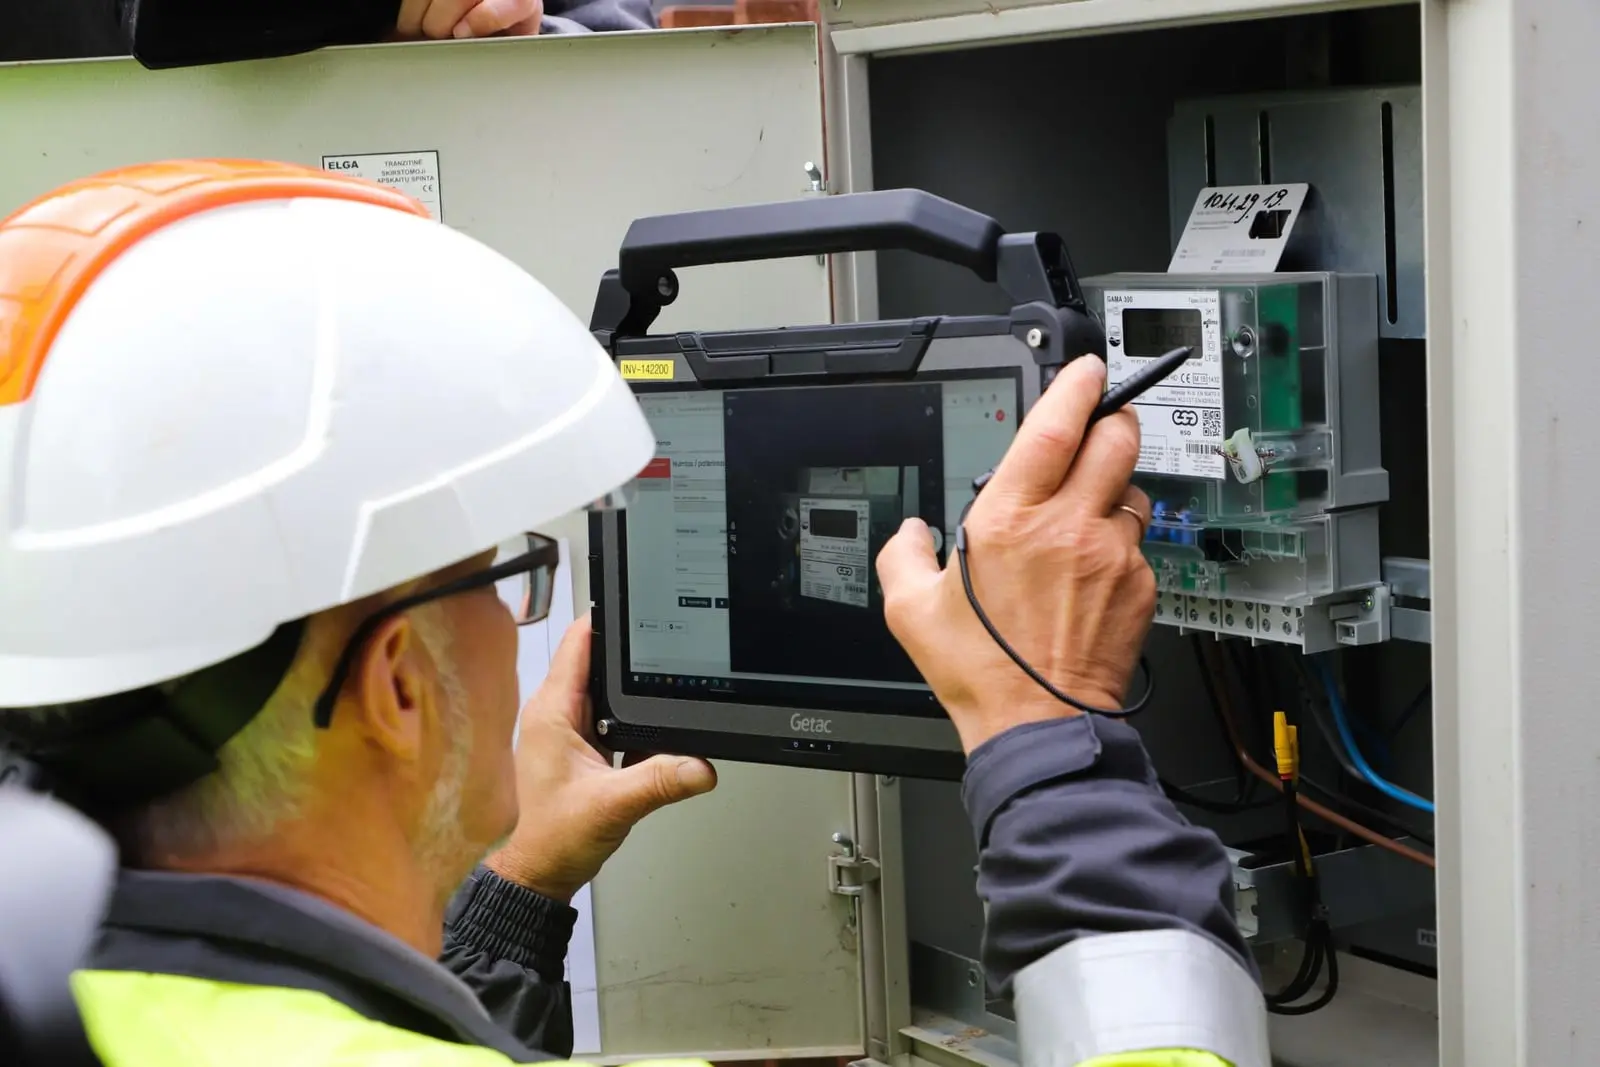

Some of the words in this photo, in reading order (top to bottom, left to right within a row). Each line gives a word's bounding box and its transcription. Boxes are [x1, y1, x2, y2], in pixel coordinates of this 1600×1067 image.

[328, 160, 359, 170] ELGA
[623, 364, 669, 375] INV-142200
[790, 713, 832, 733] Getac
